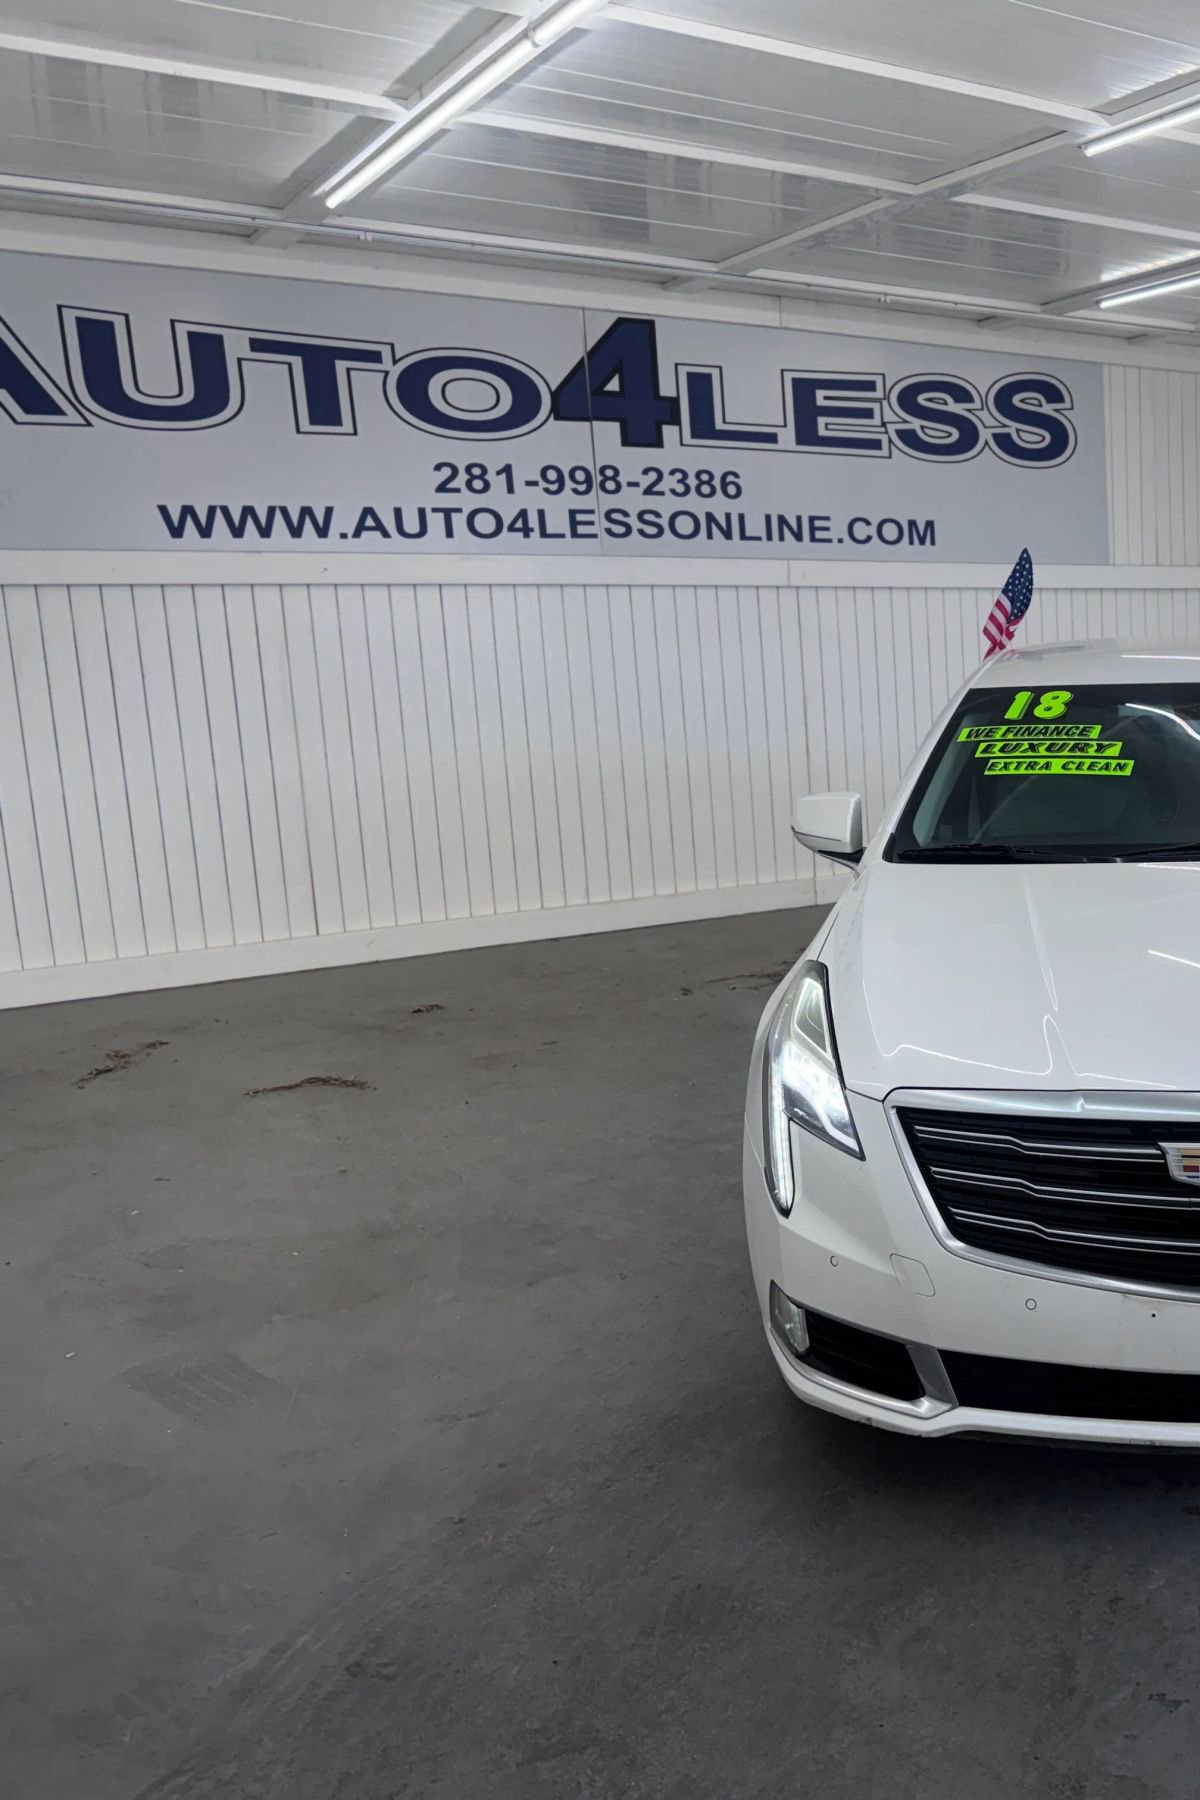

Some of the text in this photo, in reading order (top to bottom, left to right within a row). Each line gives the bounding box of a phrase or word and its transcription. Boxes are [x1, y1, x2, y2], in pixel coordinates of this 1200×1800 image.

[432, 461, 743, 500] 281-998-2386
[156, 504, 937, 547] WWW.AUTO4LESSONLINE.COM
[1004, 691, 1073, 720] 18
[966, 725, 1093, 739] WE FINANCE
[980, 742, 1114, 755] LUXURY
[987, 760, 1128, 773] EXTRA CLEAN
